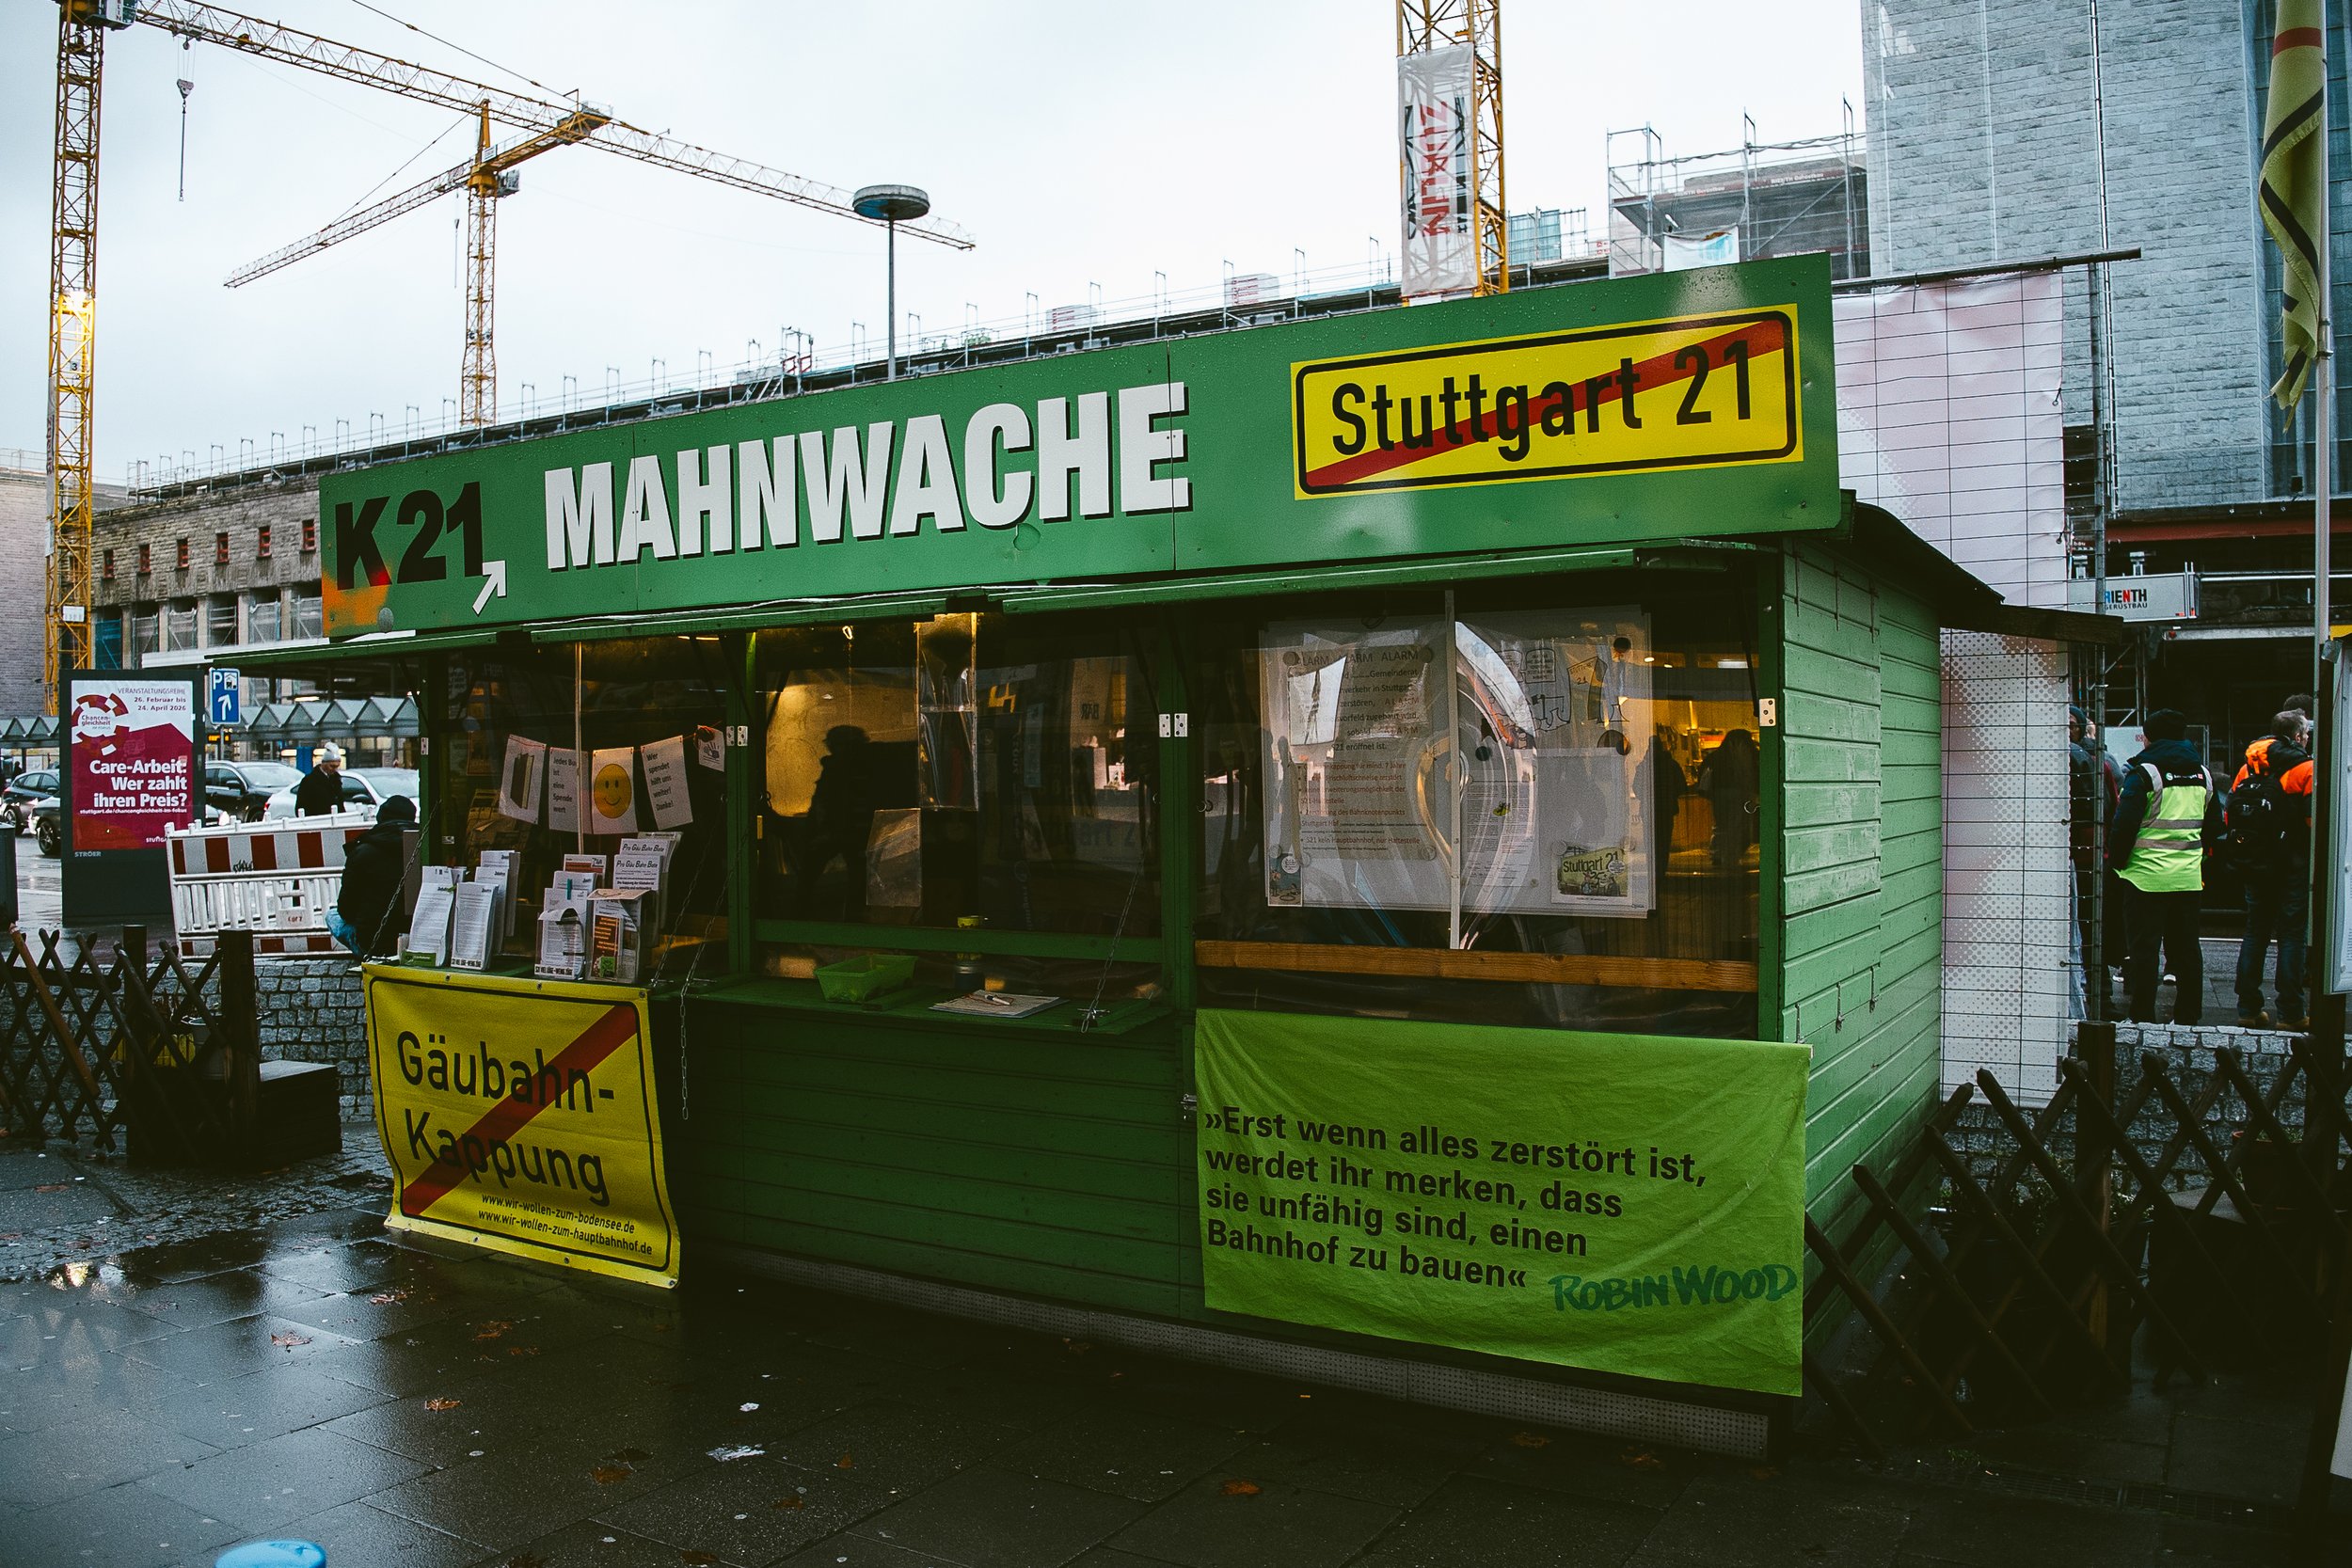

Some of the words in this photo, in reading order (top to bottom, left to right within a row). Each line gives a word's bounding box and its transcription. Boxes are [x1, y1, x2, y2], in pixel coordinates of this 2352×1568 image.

[72, 362, 78, 371] 3
[1331, 356, 1643, 463] Stuttgart
[1673, 339, 1753, 426] 21
[544, 381, 1193, 573] MAHNWACHE
[334, 481, 484, 592] K21
[1380, 650, 1419, 662] ALARM
[213, 672, 223, 690] P
[89, 758, 187, 774] Care-Arbeit:
[111, 777, 144, 790] Wer
[147, 775, 187, 790] zahlt
[93, 792, 135, 807] ihren
[139, 792, 187, 807] Preis?
[1563, 855, 1603, 873] Stuttgart
[397, 1030, 614, 1114] Gäubahn-
[405, 1108, 611, 1208] Kappung
[1205, 1105, 1287, 1140] »Erst
[1297, 1120, 1388, 1151] wenn
[1399, 1124, 1480, 1161] alles
[1490, 1138, 1637, 1179] zerstört
[1649, 1147, 1708, 1189] ist,
[1205, 1148, 1319, 1184] werdet
[1328, 1155, 1374, 1190] ihr
[1385, 1167, 1528, 1212] merken,
[1539, 1180, 1624, 1218] dass
[478, 1210, 653, 1256] www.wir-wollen-zum-hauptbahnhof.de
[481, 1194, 635, 1235] www.wir-wollen-zum-bodensee.de
[1206, 1182, 1250, 1215] sie
[1258, 1190, 1384, 1236] unfähig
[1394, 1205, 1478, 1247] sind,
[1488, 1221, 1588, 1258] einen
[1206, 1218, 1339, 1266] Bahnhof
[1348, 1244, 1389, 1273] zu
[1398, 1248, 1529, 1291] bauen«
[1548, 1273, 1670, 1313] ROBIN
[1672, 1264, 1799, 1307] WOOD
